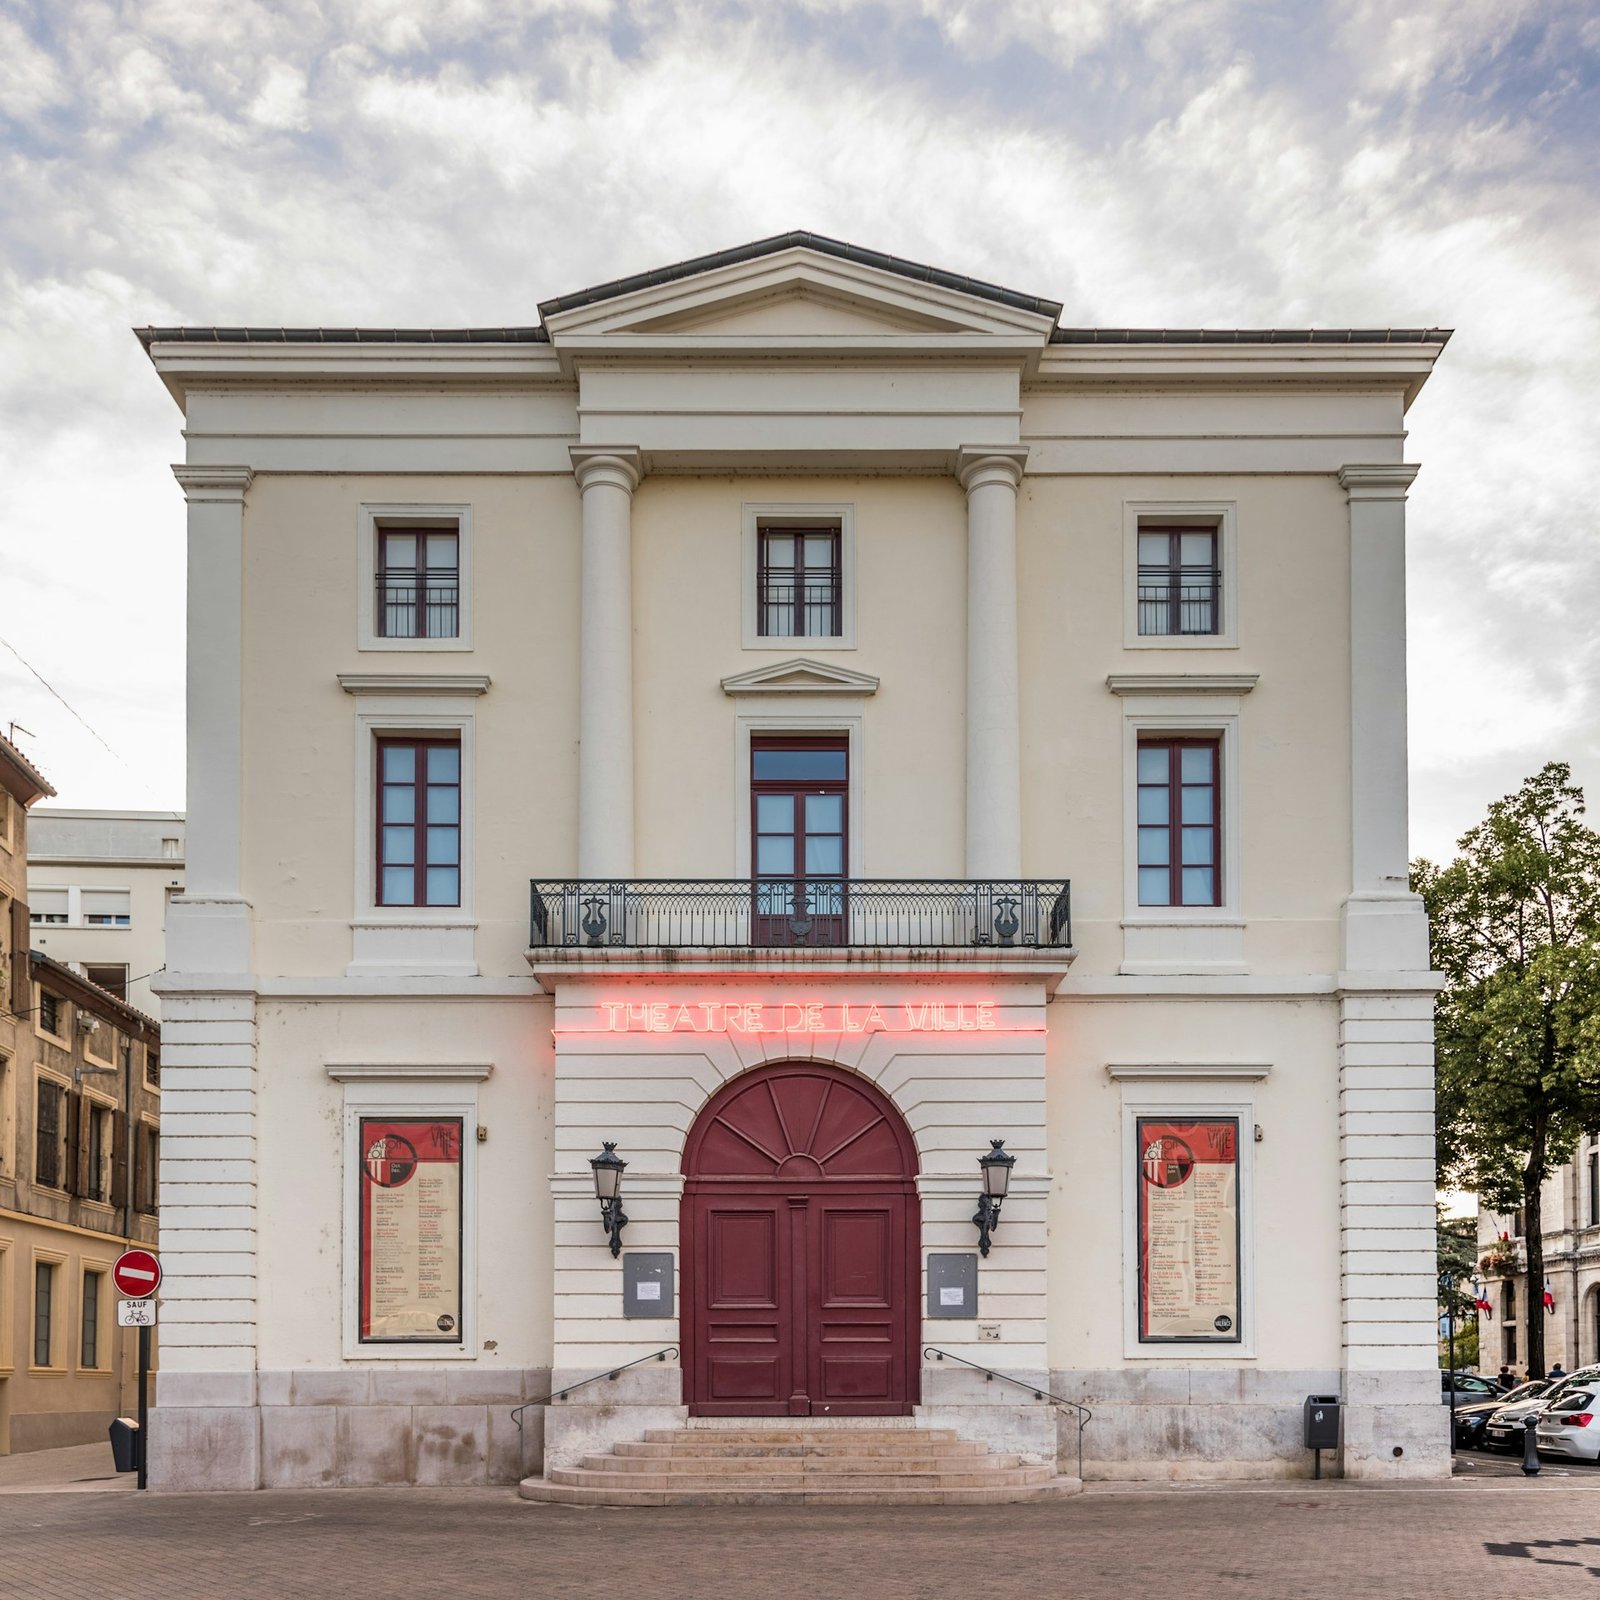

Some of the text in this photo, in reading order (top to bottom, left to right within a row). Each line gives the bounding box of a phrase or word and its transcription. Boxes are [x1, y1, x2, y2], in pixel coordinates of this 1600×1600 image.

[601, 1002, 995, 1032] THEATRE DE LA VILLE
